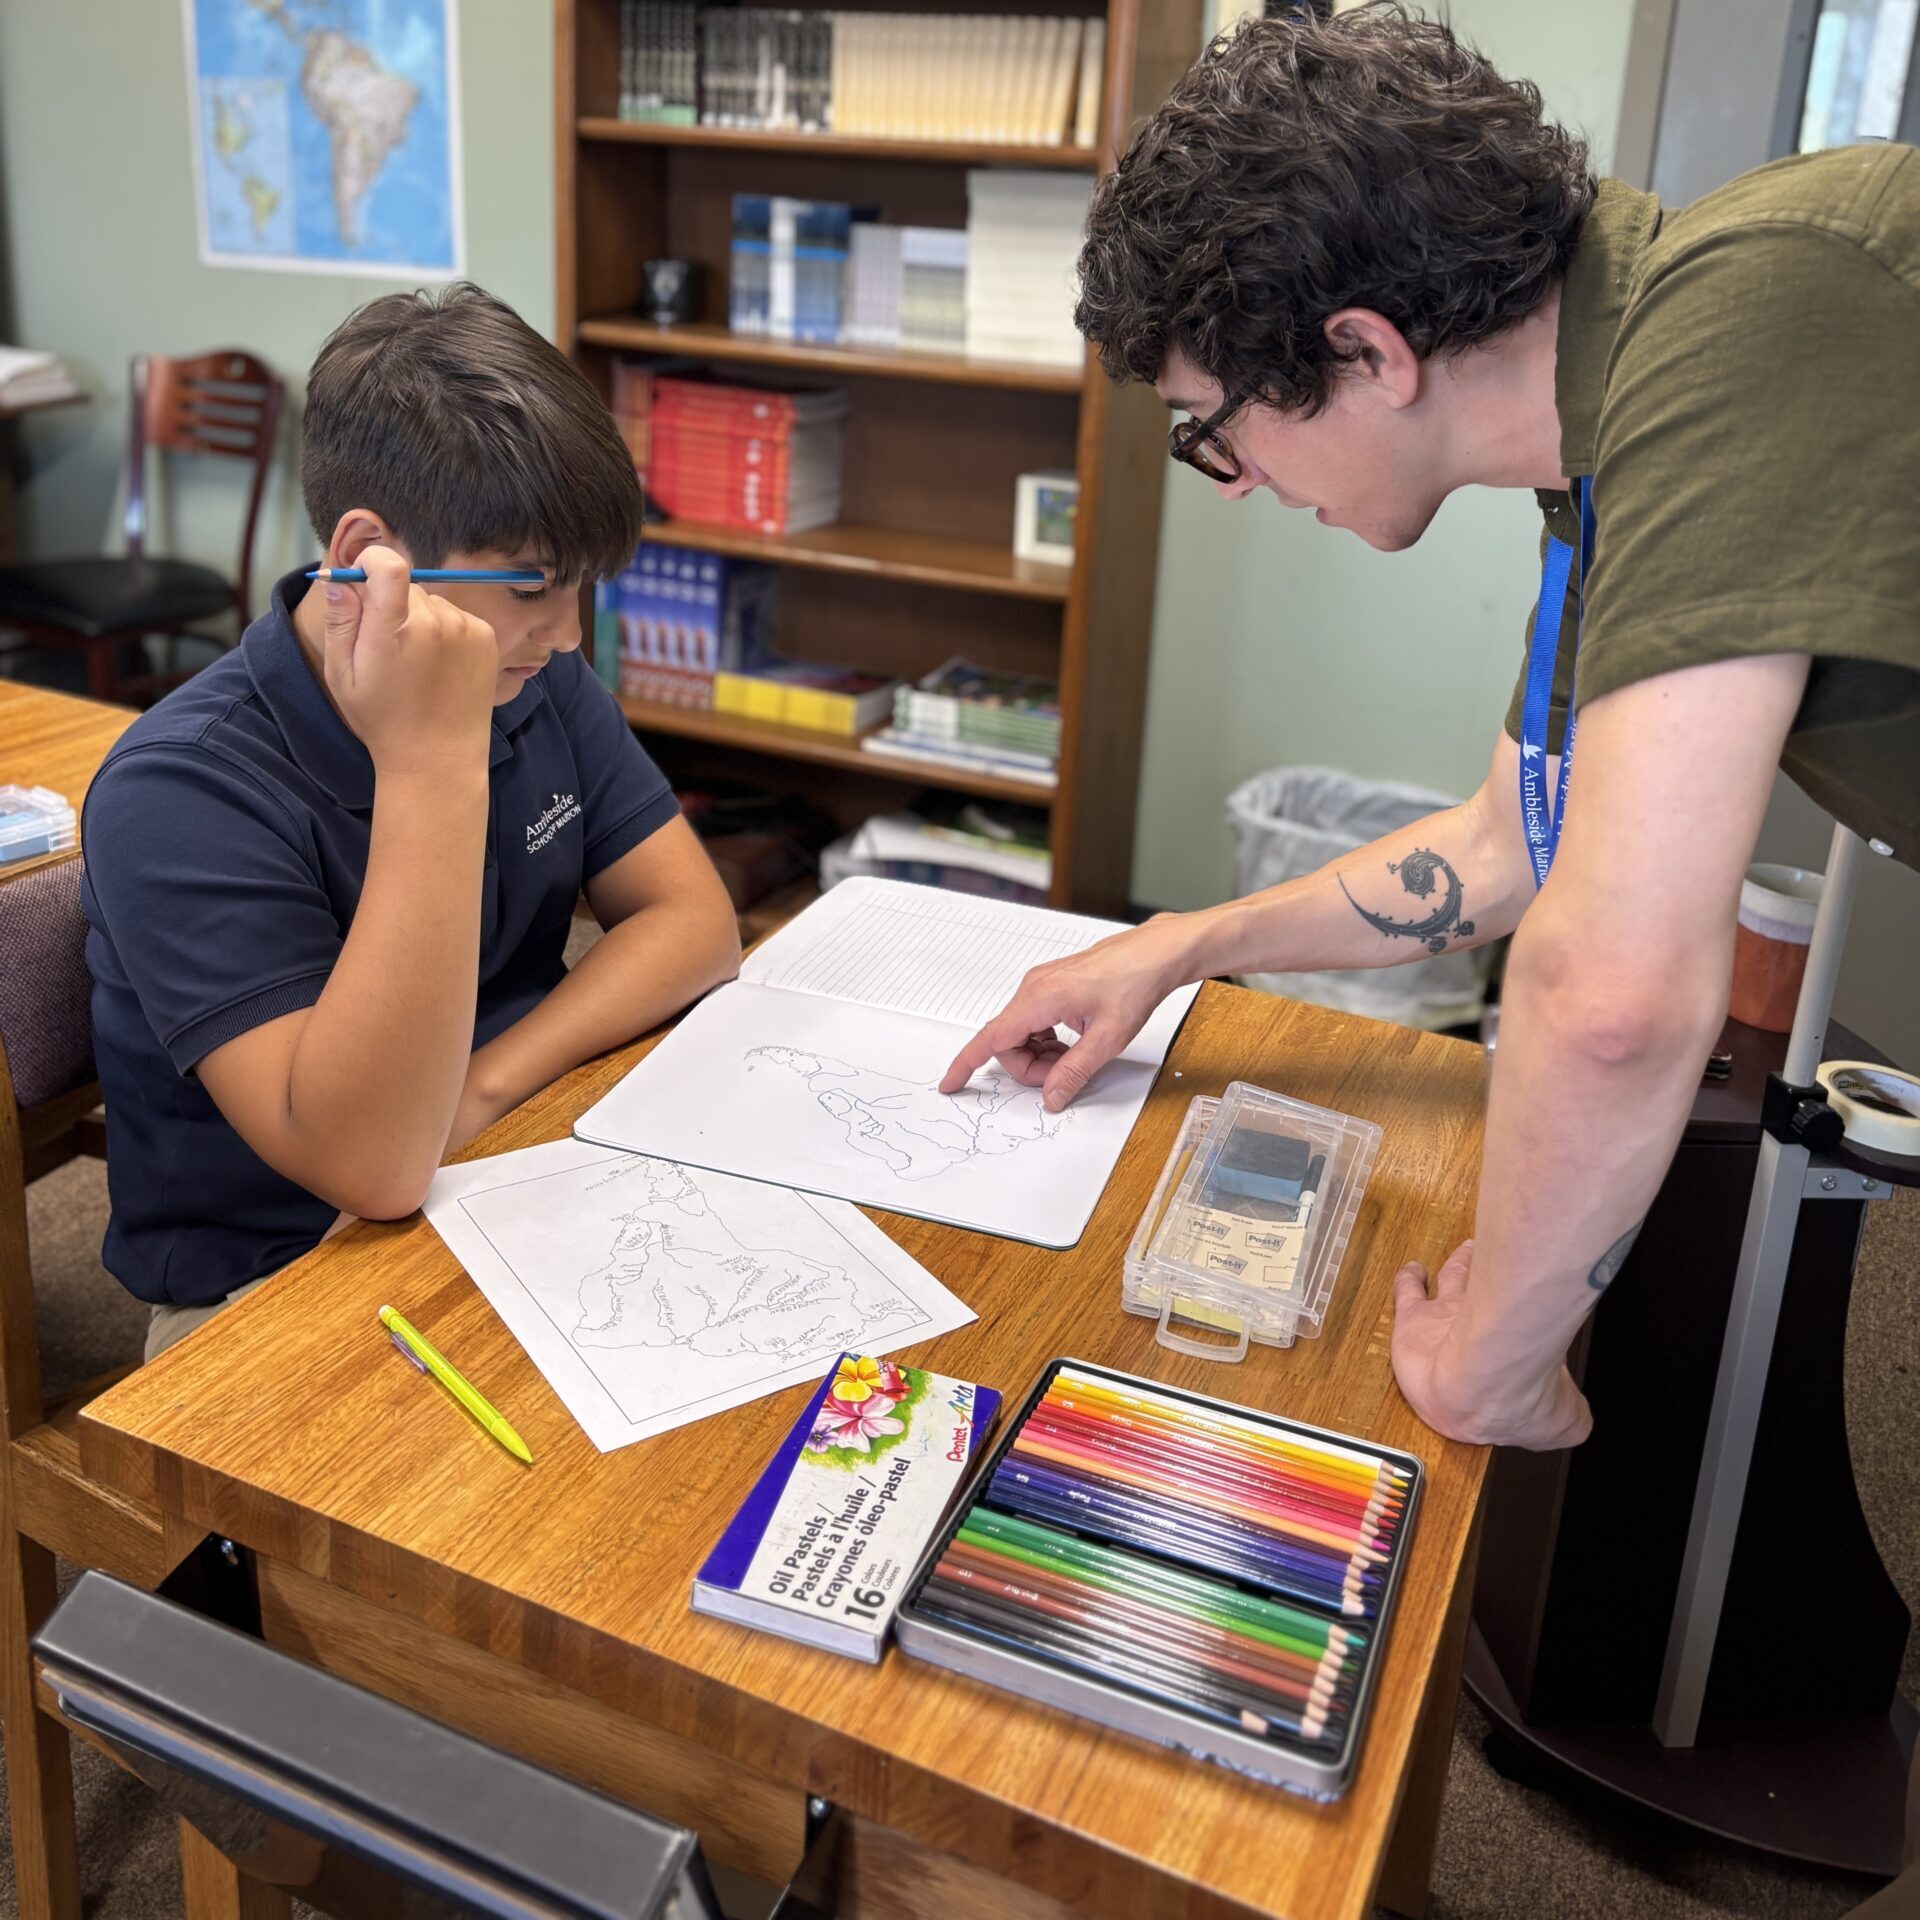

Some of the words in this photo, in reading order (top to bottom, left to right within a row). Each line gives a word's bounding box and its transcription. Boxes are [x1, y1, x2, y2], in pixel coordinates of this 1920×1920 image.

[1524, 766, 1547, 845] Ambleside
[948, 1384, 975, 1429] Arts
[946, 1427, 968, 1462] Pentel
[831, 1488, 870, 1531] l'huile
[816, 1538, 867, 1608] Crayones
[855, 1457, 911, 1536] óleo-pastel
[823, 1534, 844, 1544] à
[768, 1570, 795, 1595] Oil
[783, 1515, 828, 1570] Pastels
[791, 1546, 836, 1602] Pastels
[861, 1564, 878, 1584] Colors
[872, 1559, 893, 1587] Couleurs
[883, 1566, 901, 1591] Colores
[844, 1588, 887, 1620] 16
